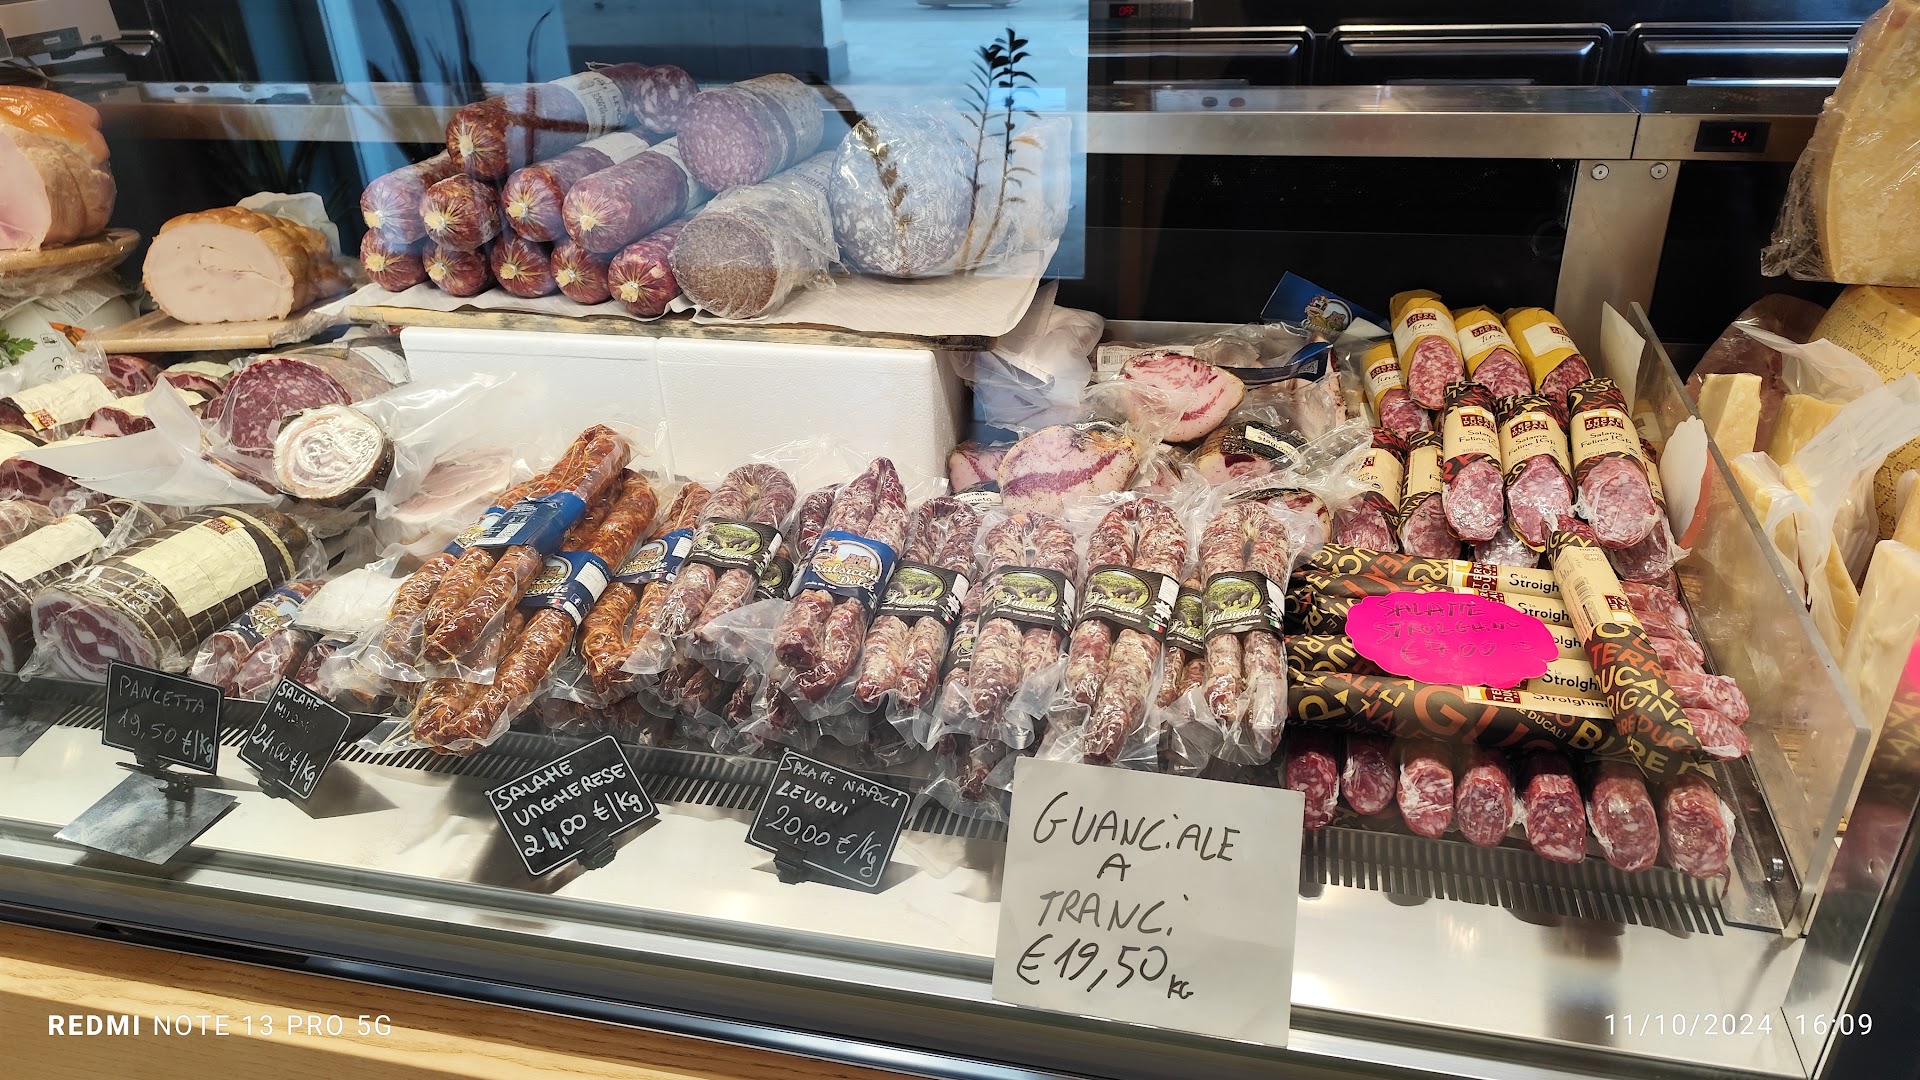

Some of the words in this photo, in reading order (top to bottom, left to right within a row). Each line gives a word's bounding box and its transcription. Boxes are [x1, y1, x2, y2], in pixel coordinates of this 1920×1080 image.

[1119, 6, 1135, 16] OFF
[1515, 434, 1548, 444] Salame
[1580, 437, 1609, 448] Felino
[1590, 430, 1623, 439] Salame
[1508, 441, 1533, 456] Felino
[811, 562, 879, 583] Salsiccia
[835, 573, 876, 593] Dolce
[881, 589, 938, 606] Salsiccia
[993, 592, 1056, 614] Salsiccia
[1082, 591, 1144, 616] Salsiccia
[1204, 608, 1262, 633] Salsiccia
[118, 675, 205, 714] PANCETTA
[277, 681, 324, 712] SALAME
[117, 707, 177, 744] 19,50
[780, 755, 837, 785] SALAME
[497, 759, 574, 811] SALAME
[512, 762, 627, 827] UNGHERESE
[1096, 852, 1132, 882] A
